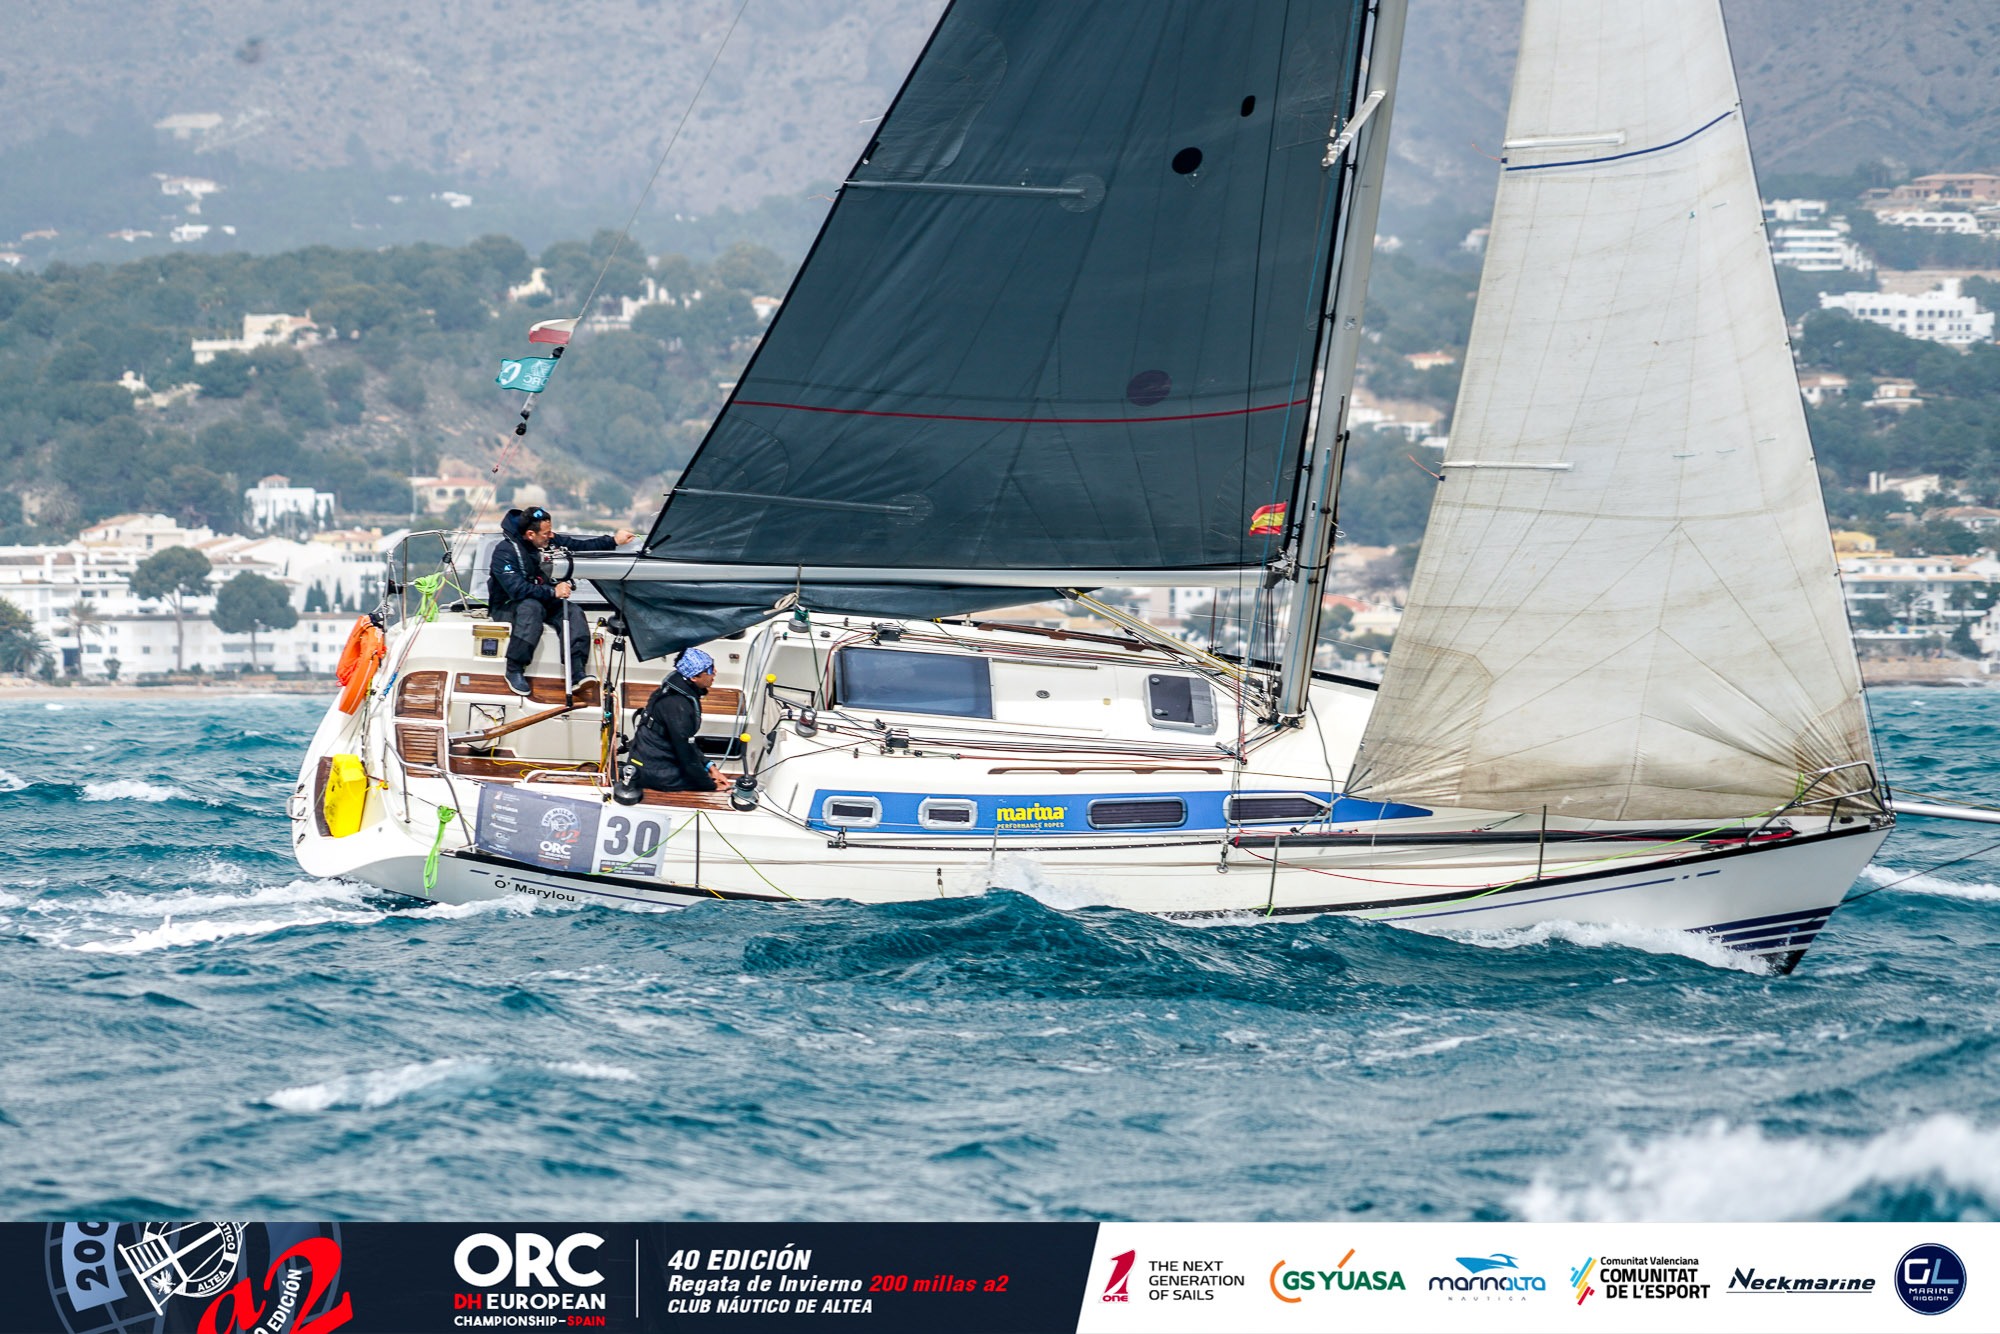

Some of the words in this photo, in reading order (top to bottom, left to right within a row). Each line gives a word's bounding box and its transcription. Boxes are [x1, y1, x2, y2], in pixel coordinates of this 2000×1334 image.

[997, 803, 1064, 821] marina
[603, 815, 661, 858] 30
[540, 841, 571, 856] ORC
[515, 883, 575, 902] Marylou
